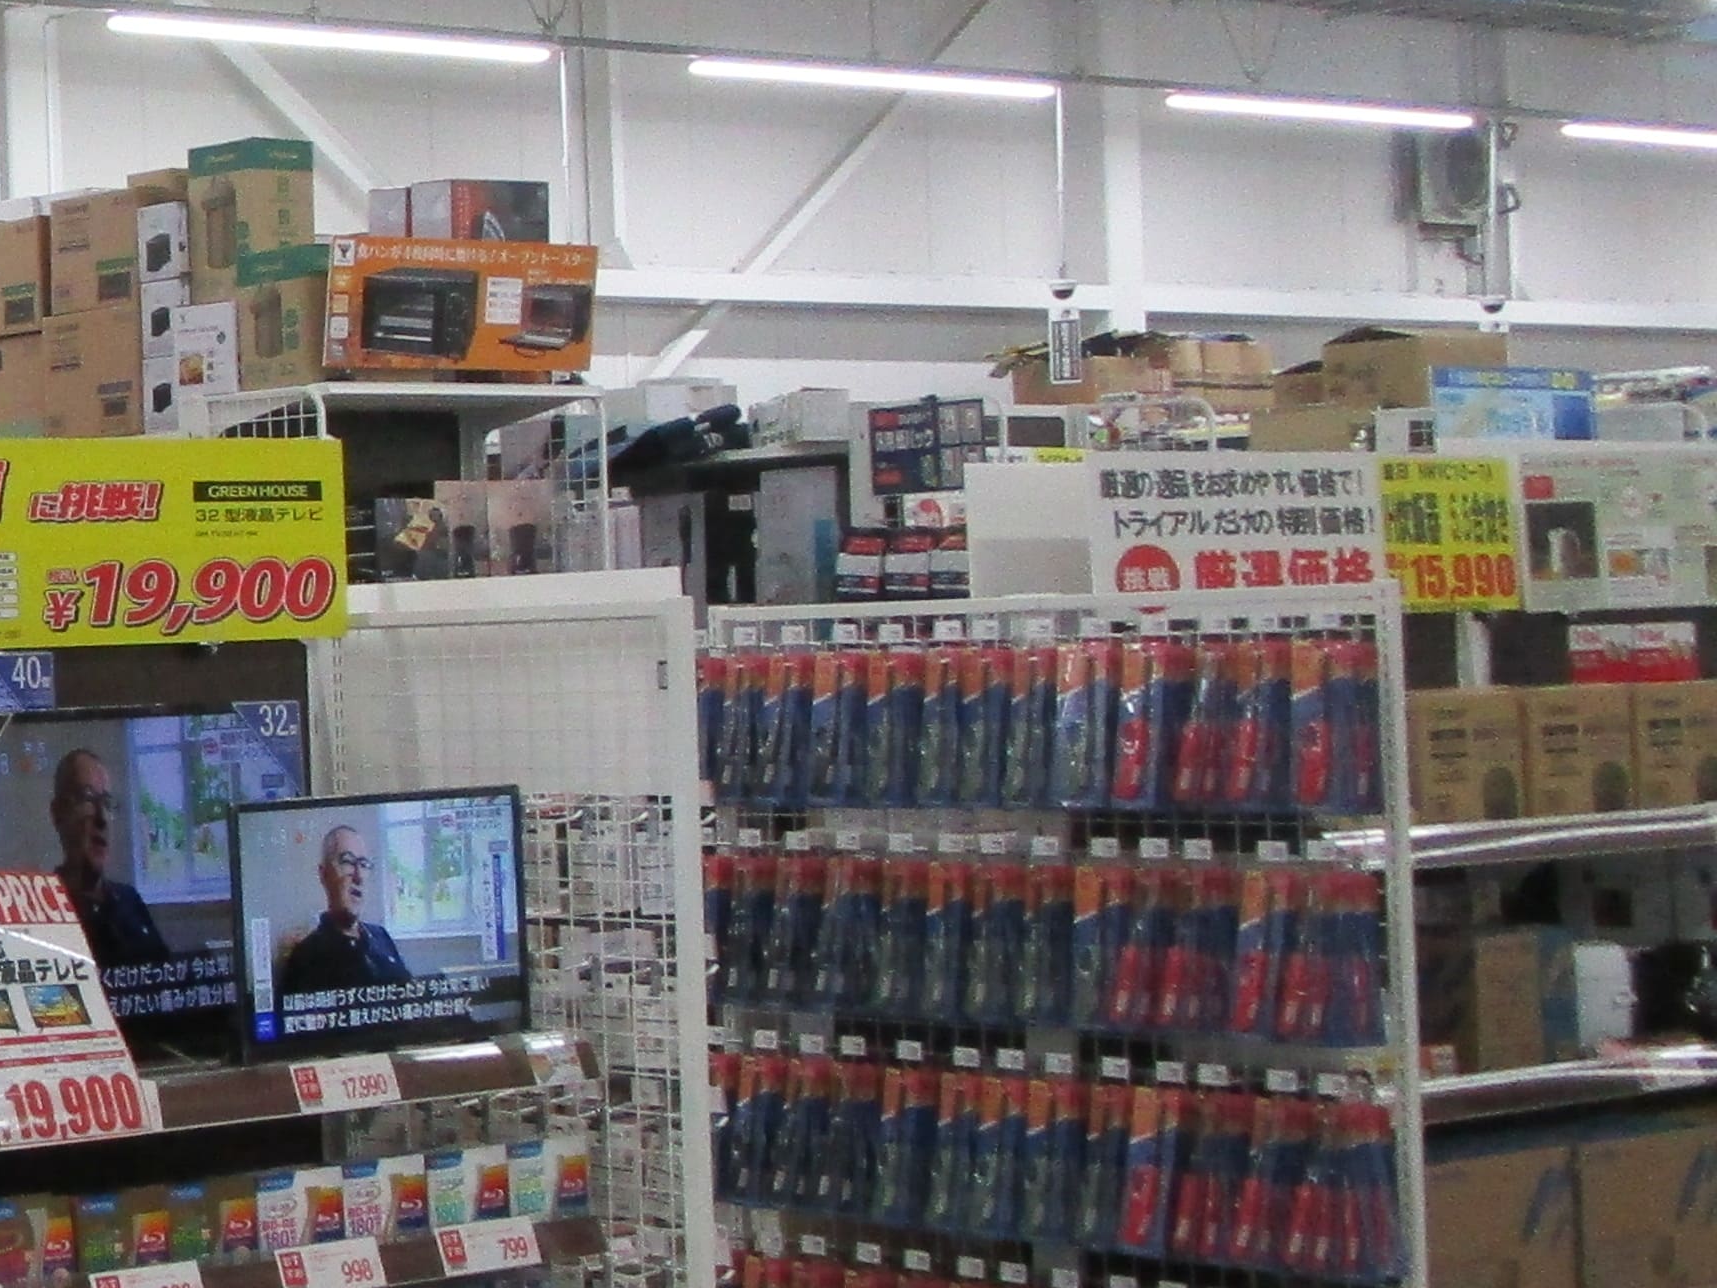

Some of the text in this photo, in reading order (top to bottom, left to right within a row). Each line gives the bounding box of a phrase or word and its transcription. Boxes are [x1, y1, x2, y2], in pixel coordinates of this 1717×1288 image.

[208, 484, 309, 498] GREEN HOUSE
[1196, 546, 1373, 589] 厳選価格
[500, 1235, 529, 1261] 799
[342, 1259, 373, 1284] 998
